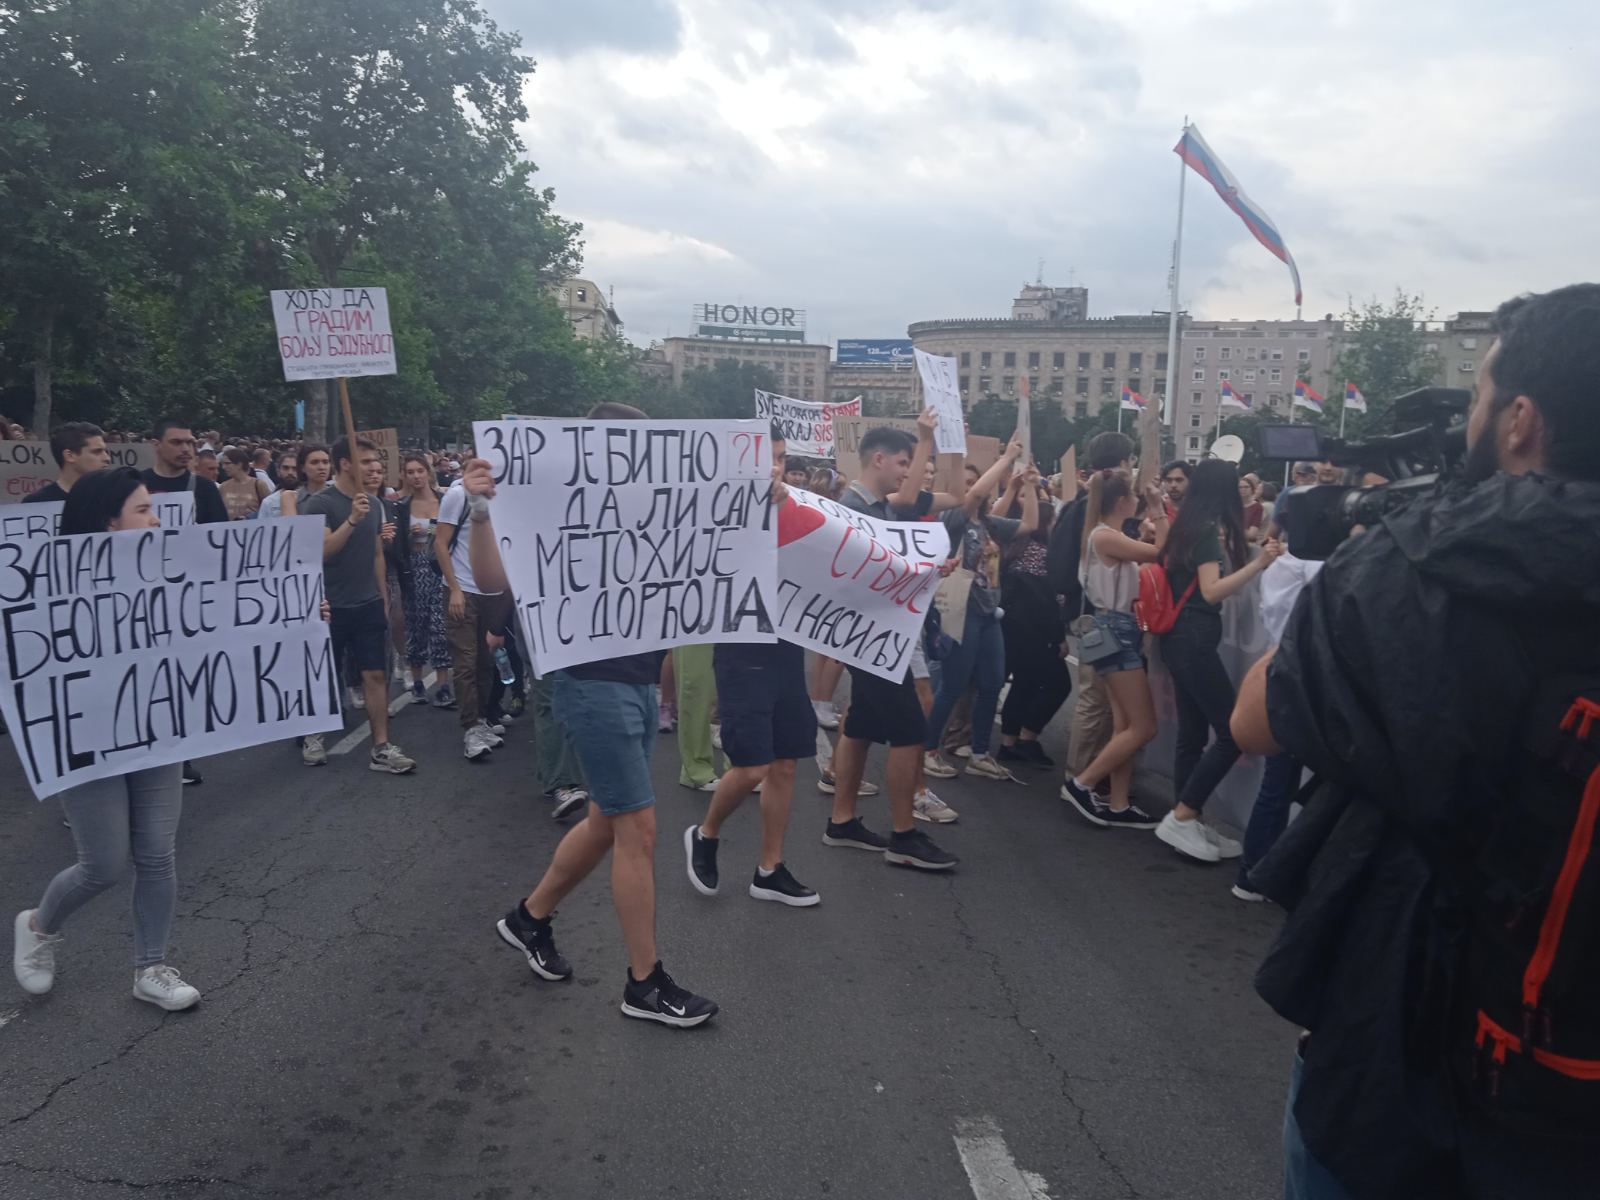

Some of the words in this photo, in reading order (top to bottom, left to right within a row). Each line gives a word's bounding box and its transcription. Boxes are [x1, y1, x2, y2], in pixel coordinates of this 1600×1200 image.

[285, 289, 332, 311] ХОЋУ
[342, 288, 375, 310] ДА
[293, 310, 373, 333] ГРАДИМ
[703, 302, 796, 327] HONOR
[279, 336, 321, 359] БОЉУ
[328, 334, 393, 357] БУДУЋНОСТ
[757, 391, 780, 415] SVE
[483, 426, 546, 486] ЗАР
[559, 487, 622, 531] ДА
[636, 487, 698, 531] ЛИ
[711, 480, 772, 531] САМ
[0, 536, 117, 602] ЗАПАД
[136, 529, 188, 584] СЕ
[208, 525, 304, 582] ЧУДИ.
[536, 526, 740, 598] МЕТОХИЈЕ
[886, 528, 937, 558] ЈЕ
[3, 586, 172, 680] БЕОГРАД
[180, 581, 217, 638] СЕ
[233, 572, 325, 629] БУДИ
[557, 596, 575, 645] С
[589, 576, 776, 642] ДОРЋОЛА
[795, 593, 910, 671] НАСИЉУ
[14, 670, 96, 784] НЕ
[100, 650, 237, 762] ДАМО
